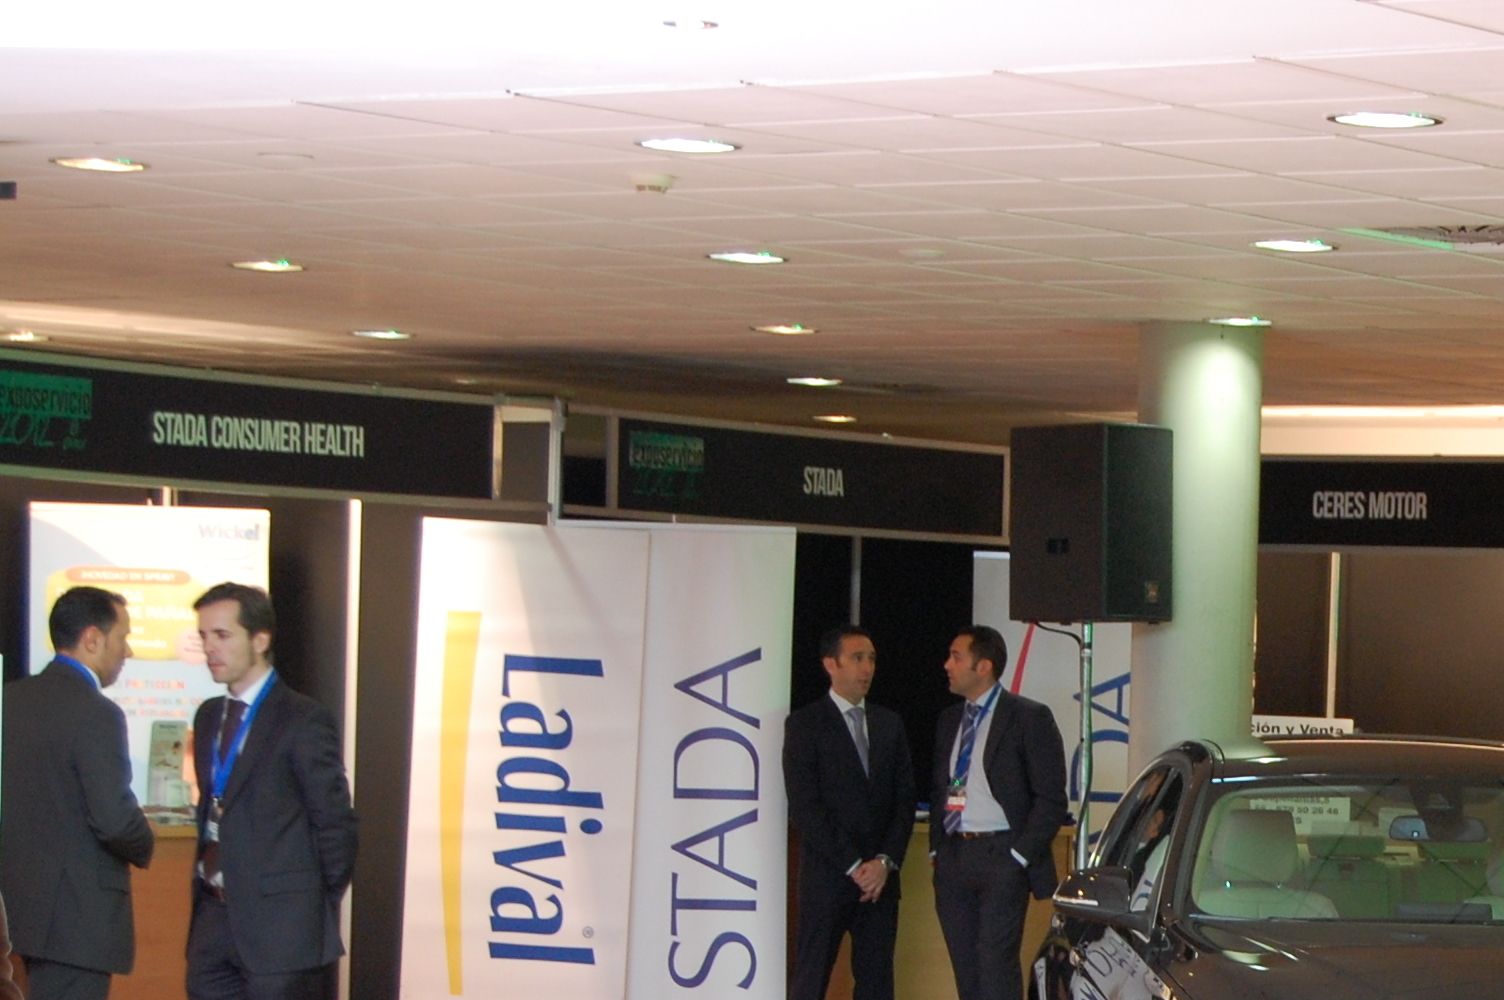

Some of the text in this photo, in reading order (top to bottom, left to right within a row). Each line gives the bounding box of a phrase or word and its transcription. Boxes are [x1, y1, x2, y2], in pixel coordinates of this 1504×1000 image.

[153, 411, 365, 458] STADA CONSUMER HEALTH
[803, 466, 844, 497] STADA
[1312, 491, 1428, 519] CERES MOTOR
[488, 653, 605, 966] Ladival
[668, 646, 762, 991] STADA
